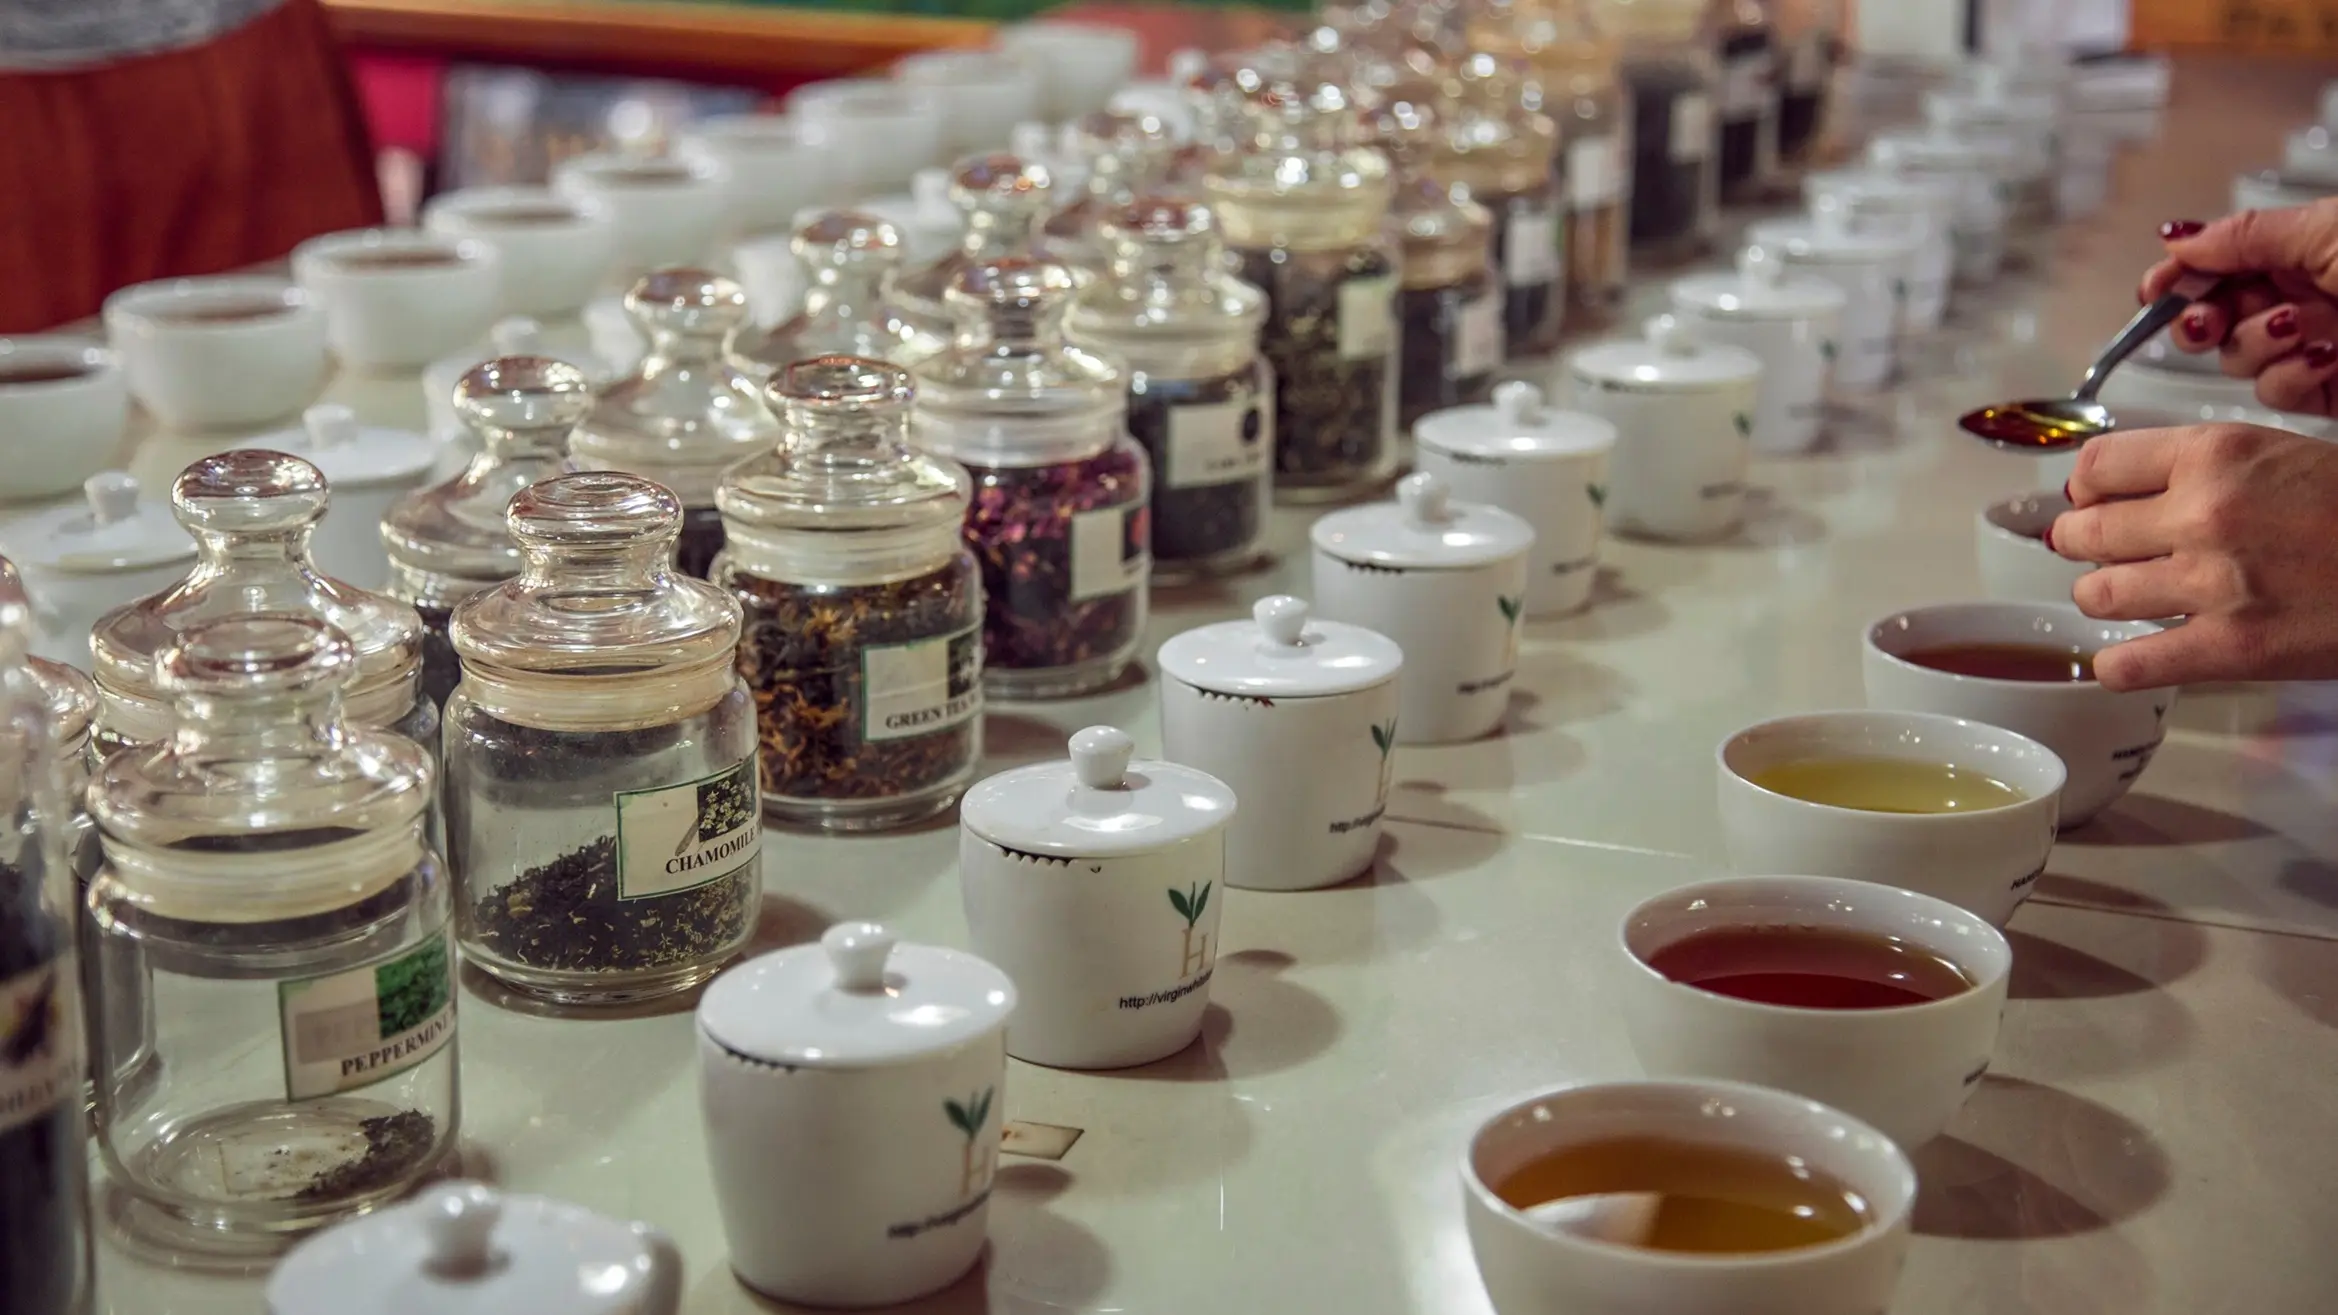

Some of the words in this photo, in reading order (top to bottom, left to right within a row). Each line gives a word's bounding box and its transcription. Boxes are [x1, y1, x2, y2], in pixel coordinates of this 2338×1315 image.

[885, 707, 941, 730] GREEN
[665, 826, 754, 875] CHAMOMILE
[341, 1011, 449, 1077] PEPPERMINT
